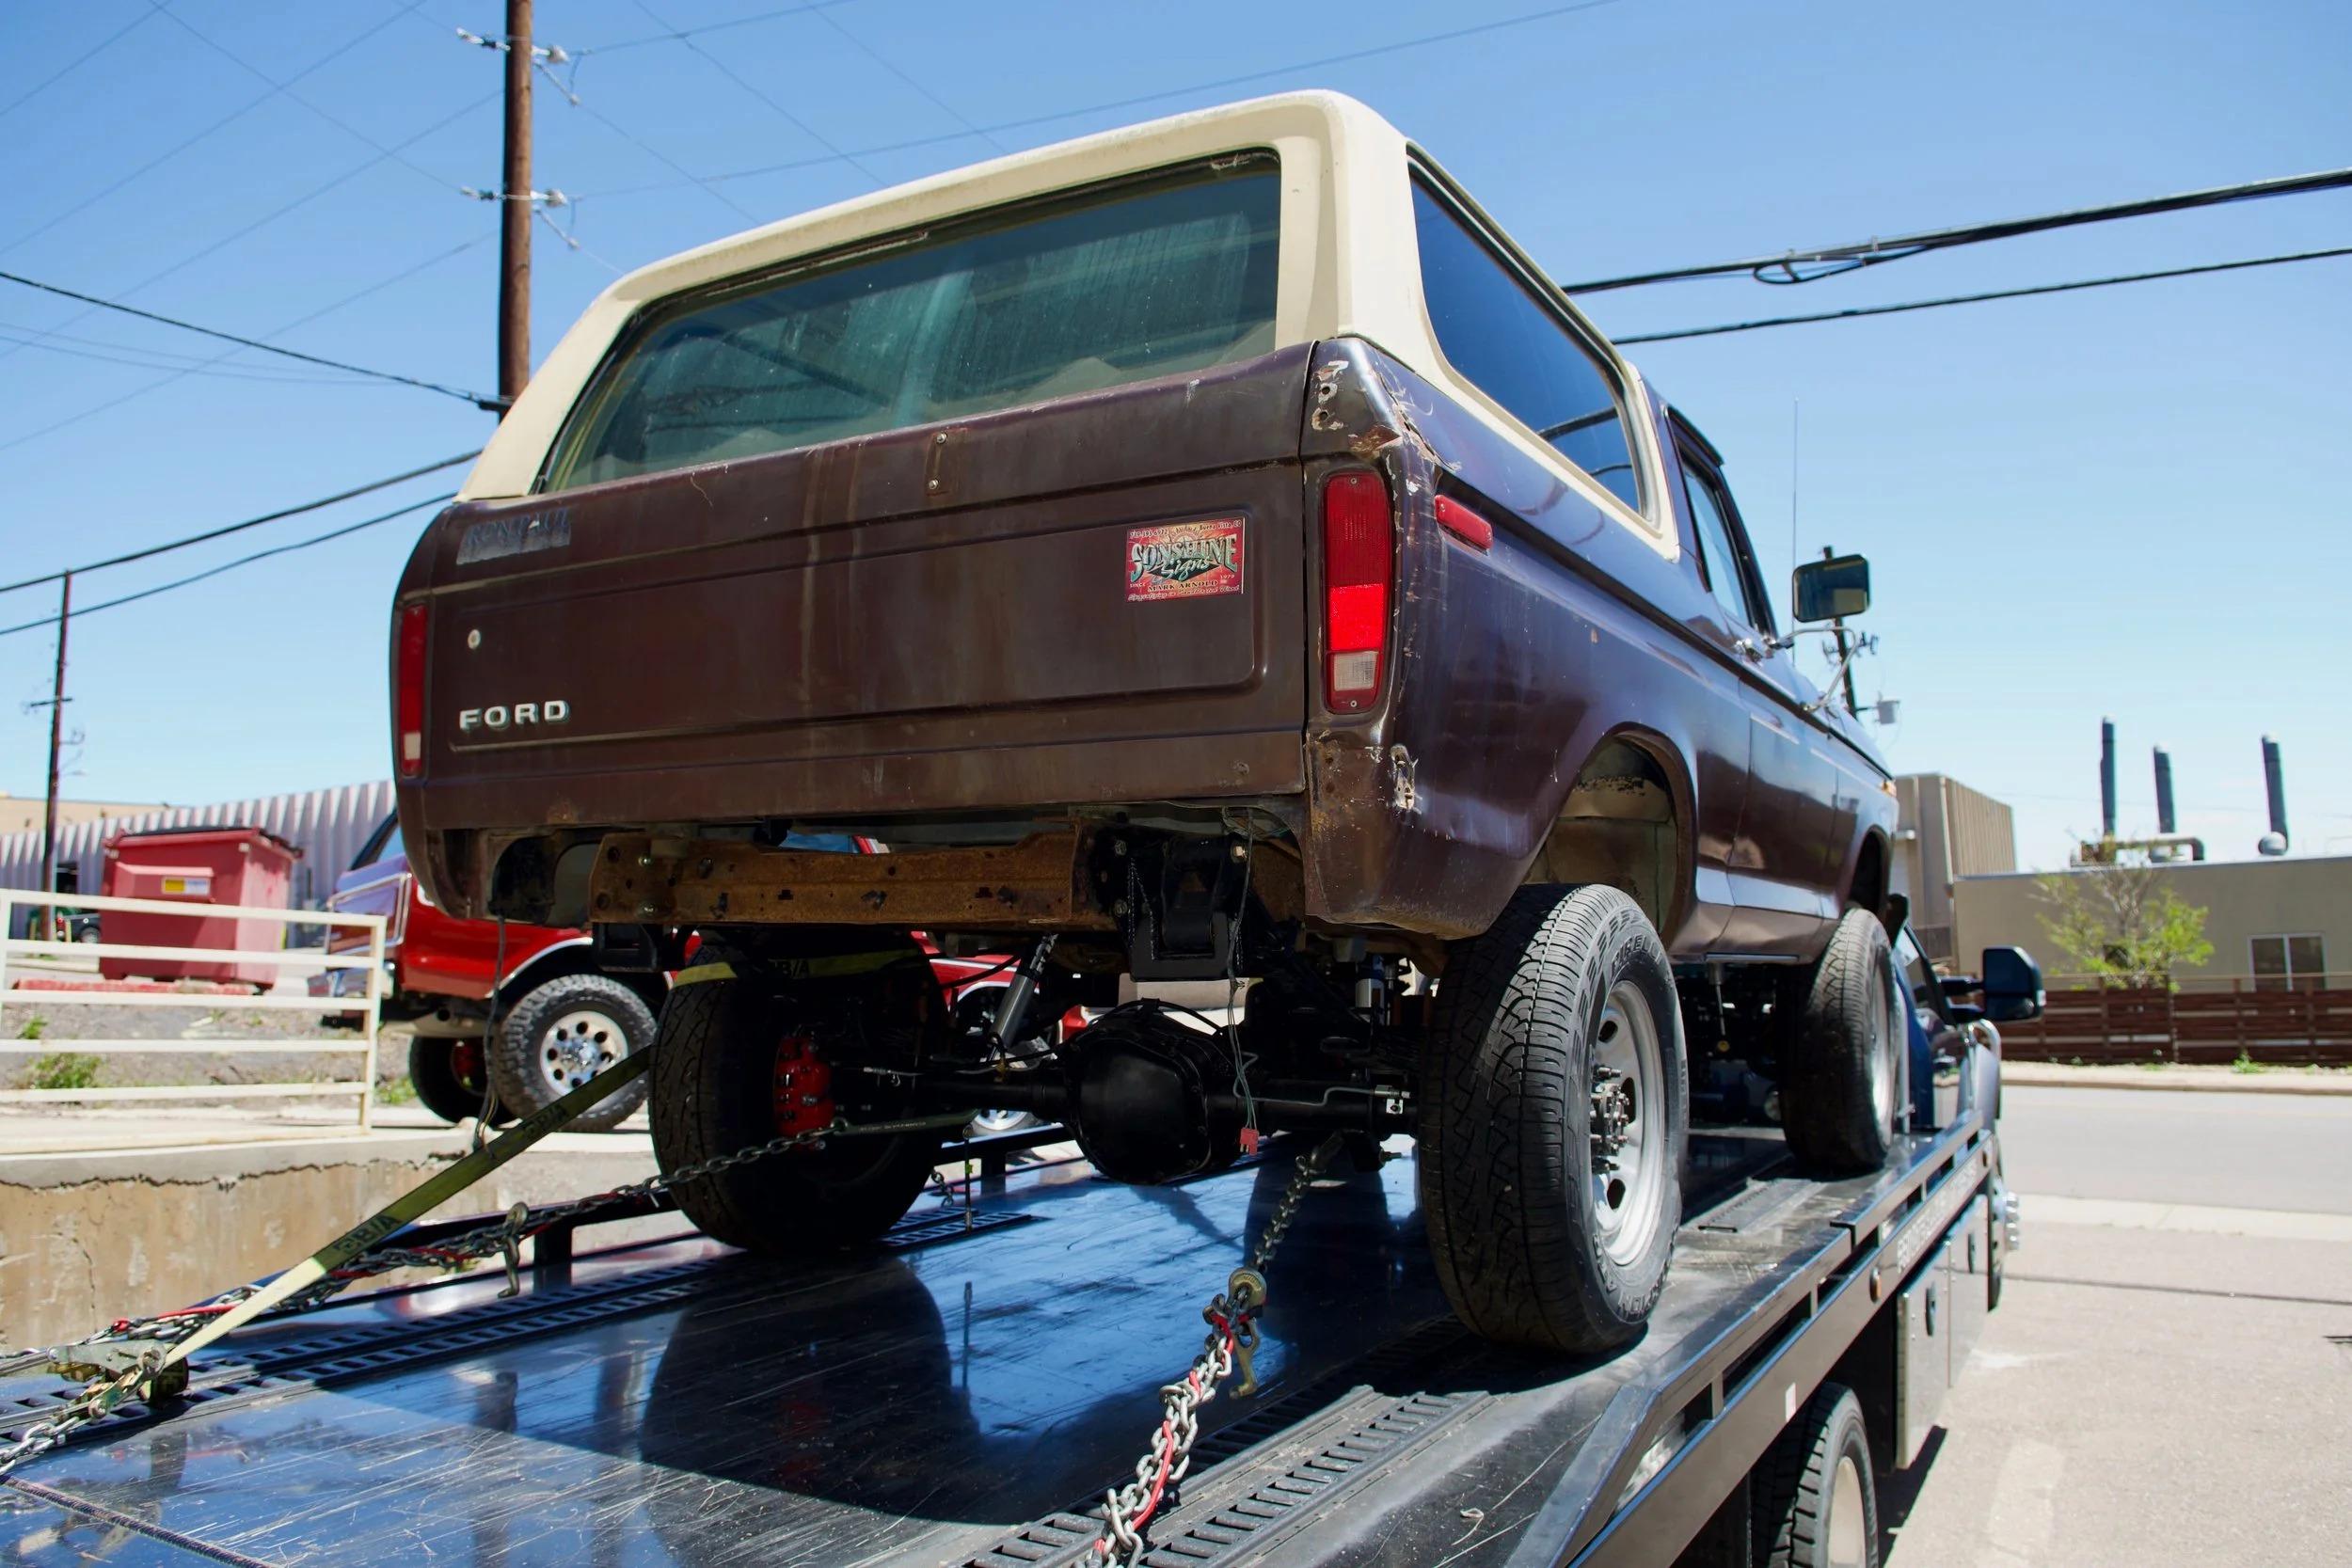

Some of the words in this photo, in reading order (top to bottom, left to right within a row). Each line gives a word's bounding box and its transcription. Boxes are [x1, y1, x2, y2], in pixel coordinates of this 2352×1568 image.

[1147, 584, 1175, 593] MARK
[1178, 579, 1218, 589] ARNOLD
[459, 700, 570, 734] FORD
